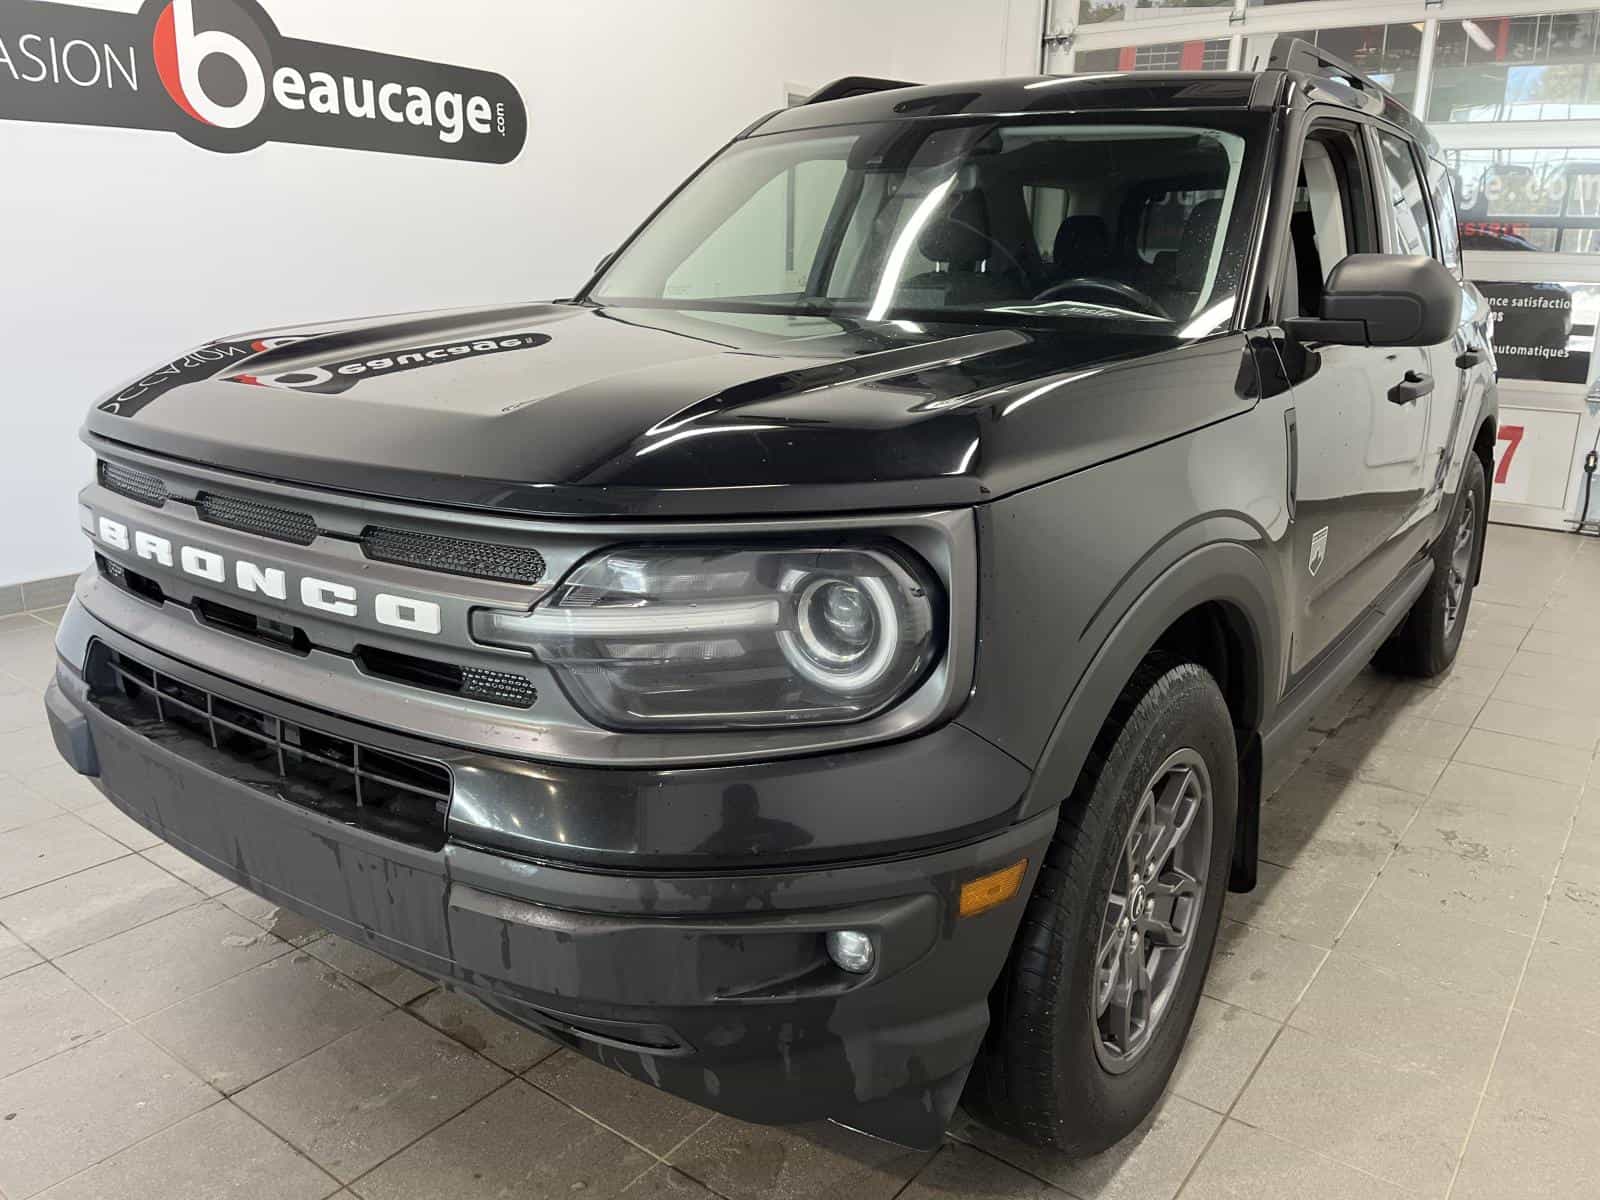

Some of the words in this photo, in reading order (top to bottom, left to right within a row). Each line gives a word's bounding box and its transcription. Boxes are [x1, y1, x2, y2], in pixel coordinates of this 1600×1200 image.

[496, 103, 505, 136] .com
[1485, 298, 1509, 306] nce
[99, 516, 441, 634] BRONCO
